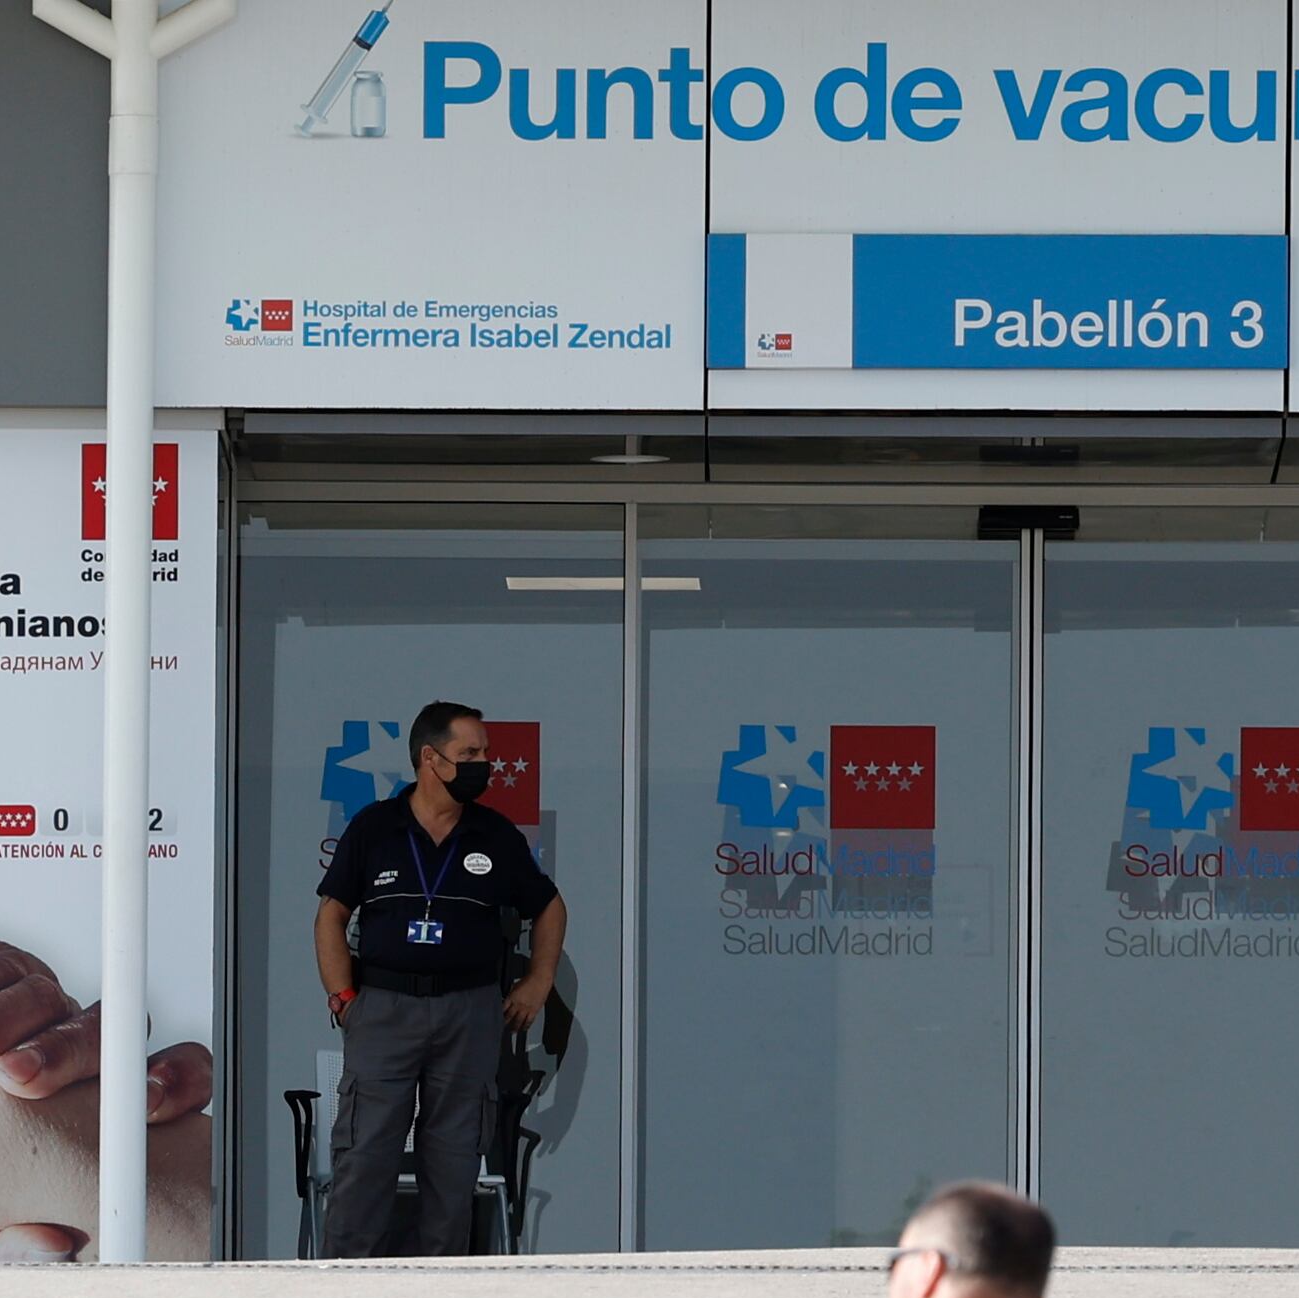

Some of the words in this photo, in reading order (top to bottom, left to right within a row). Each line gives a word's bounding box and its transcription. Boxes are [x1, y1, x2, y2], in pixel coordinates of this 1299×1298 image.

[423, 40, 785, 142] Punto
[813, 42, 963, 142] de
[303, 300, 386, 321] Hospital
[392, 300, 419, 317] de
[424, 300, 559, 322] Emergencias
[302, 322, 460, 348] Enfermera
[470, 322, 559, 349] Isabel
[567, 323, 672, 349] Zendal
[954, 298, 1209, 349] Pabellón
[1229, 299, 1265, 349] 3
[224, 335, 293, 346] SaludMadrid
[81, 549, 179, 562] Codad
[81, 568, 105, 581] de
[70, 844, 89, 858] AL
[715, 843, 936, 876] SaludMadrid
[723, 924, 934, 956] SaludMadrid
